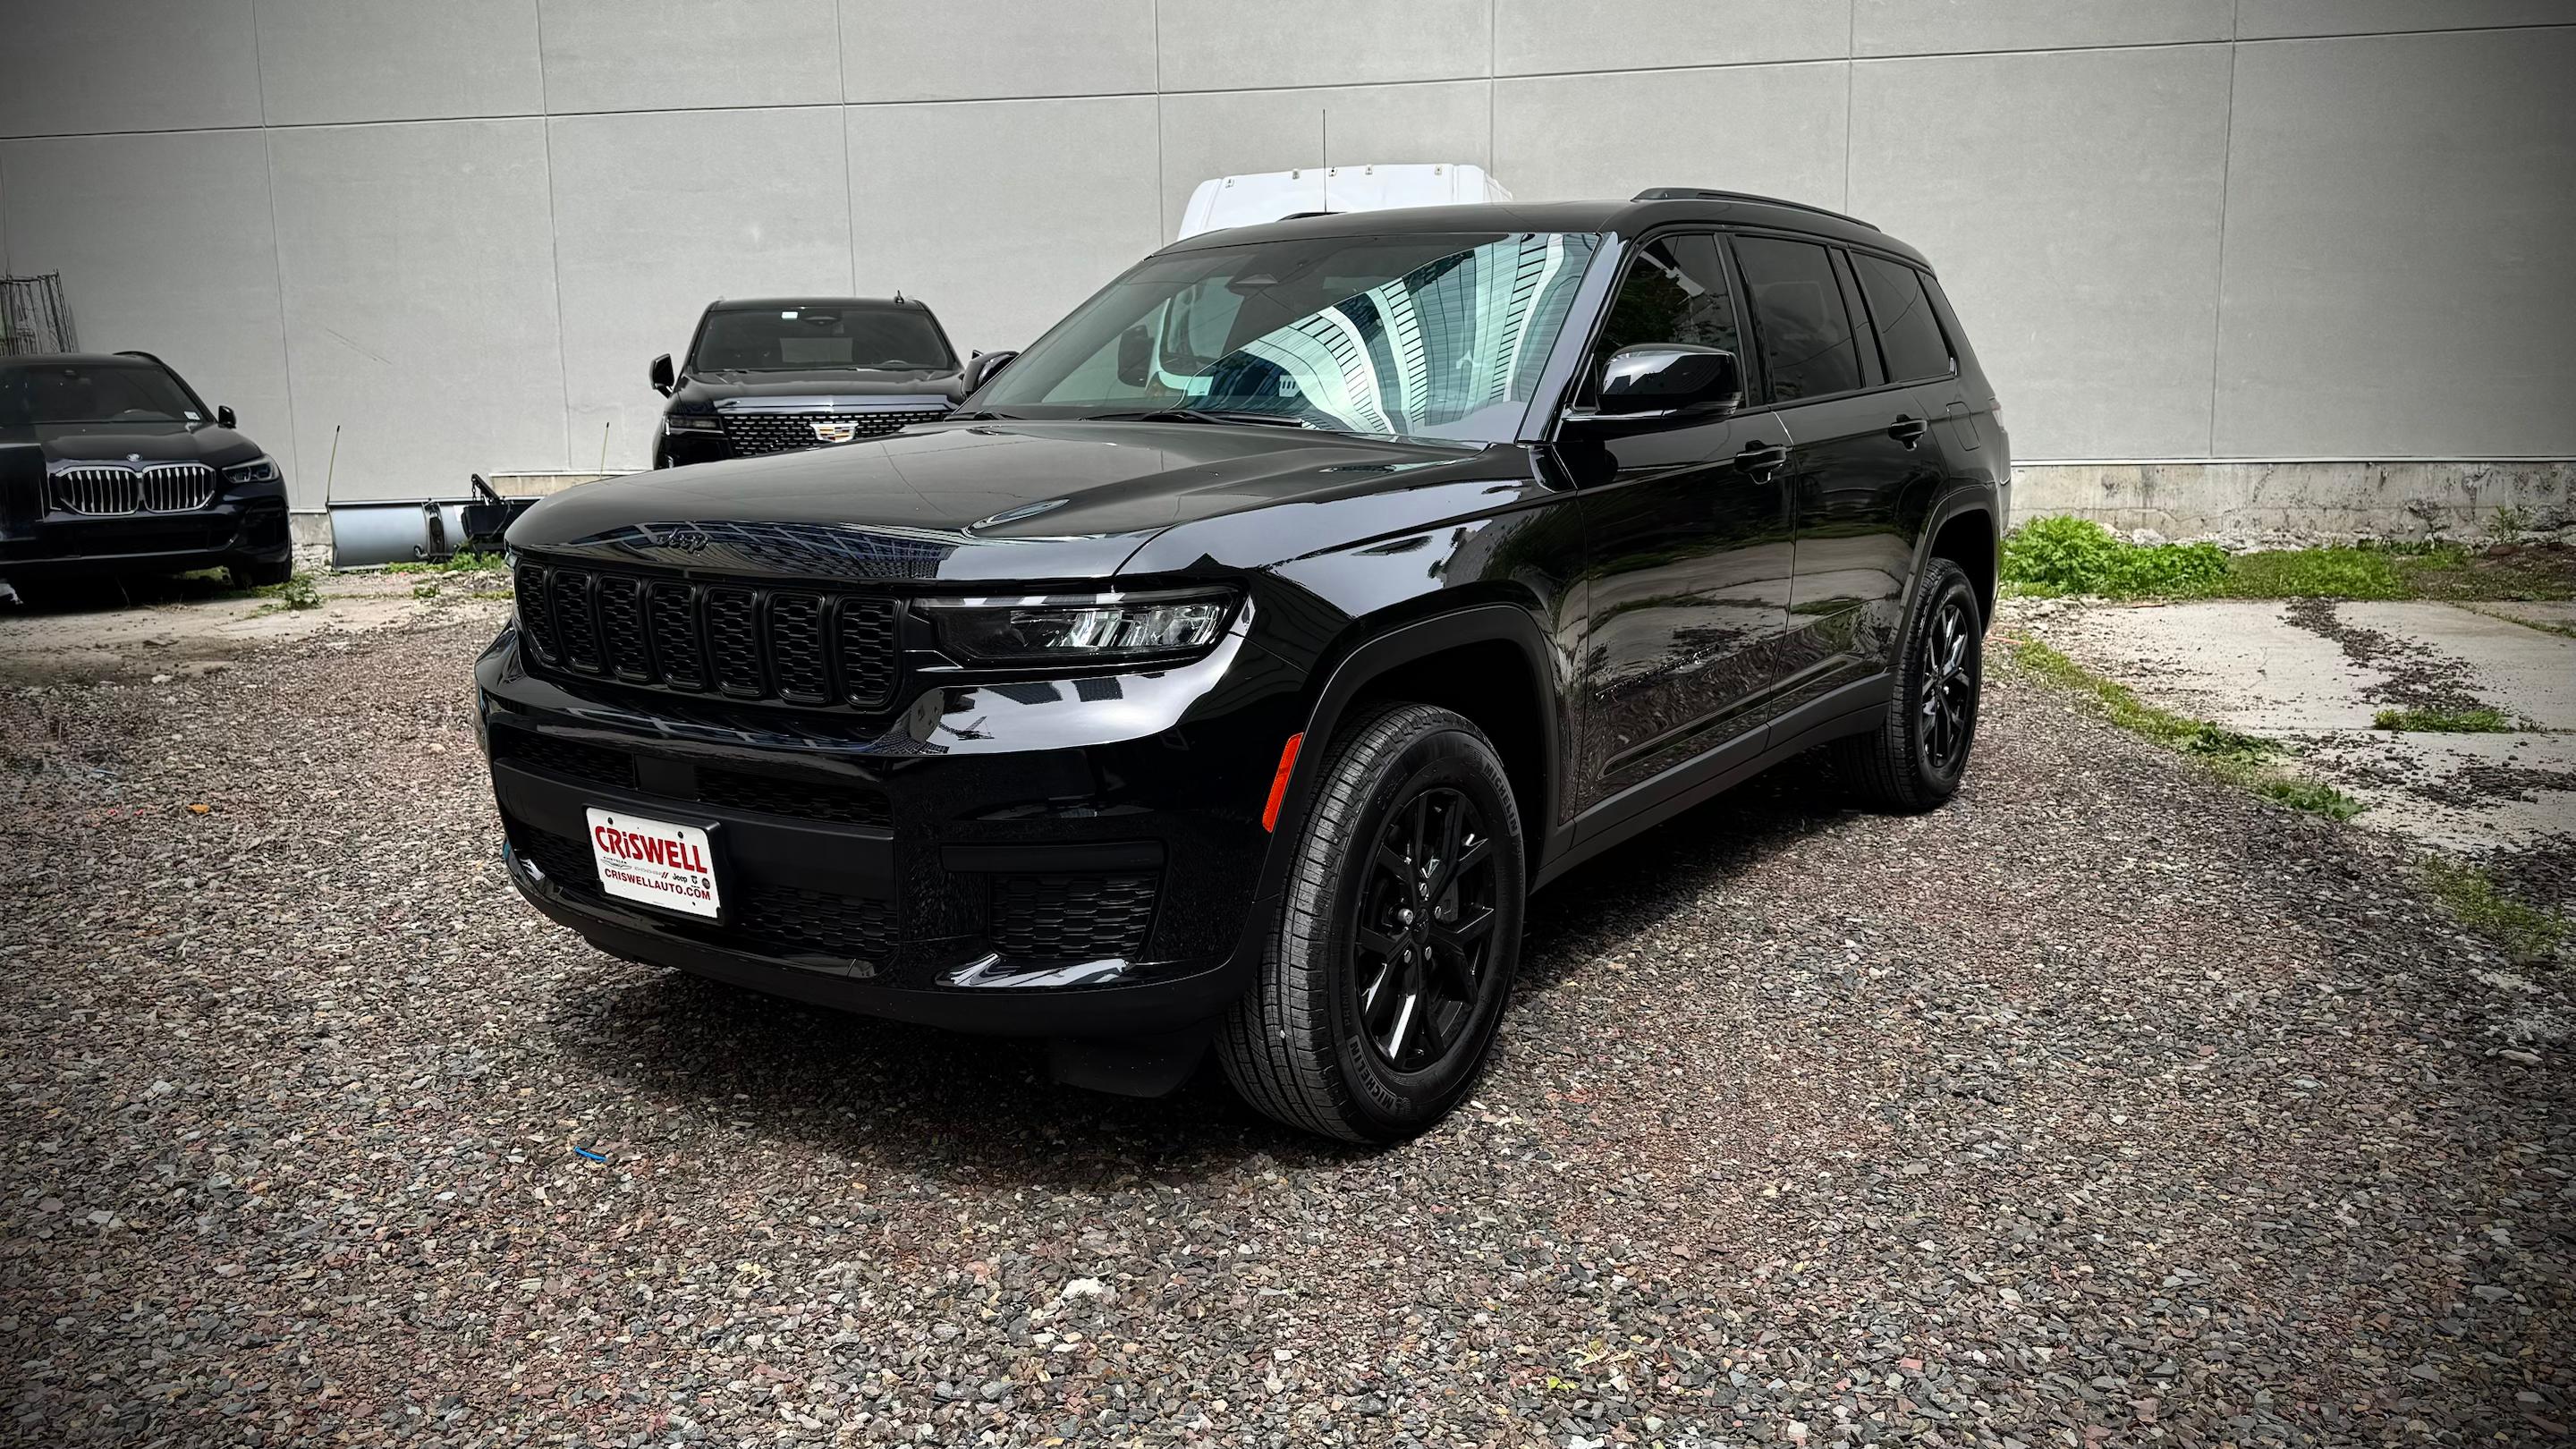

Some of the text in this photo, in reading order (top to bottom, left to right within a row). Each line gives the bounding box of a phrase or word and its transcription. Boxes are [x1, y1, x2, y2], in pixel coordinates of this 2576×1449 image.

[657, 527, 708, 554] Jeep
[1483, 762, 1518, 833] MICHELIN
[605, 869, 711, 901] CRISWELLAUTO.COM
[672, 873, 688, 883] Jeep
[1350, 1039, 1394, 1110] MICHELIN
